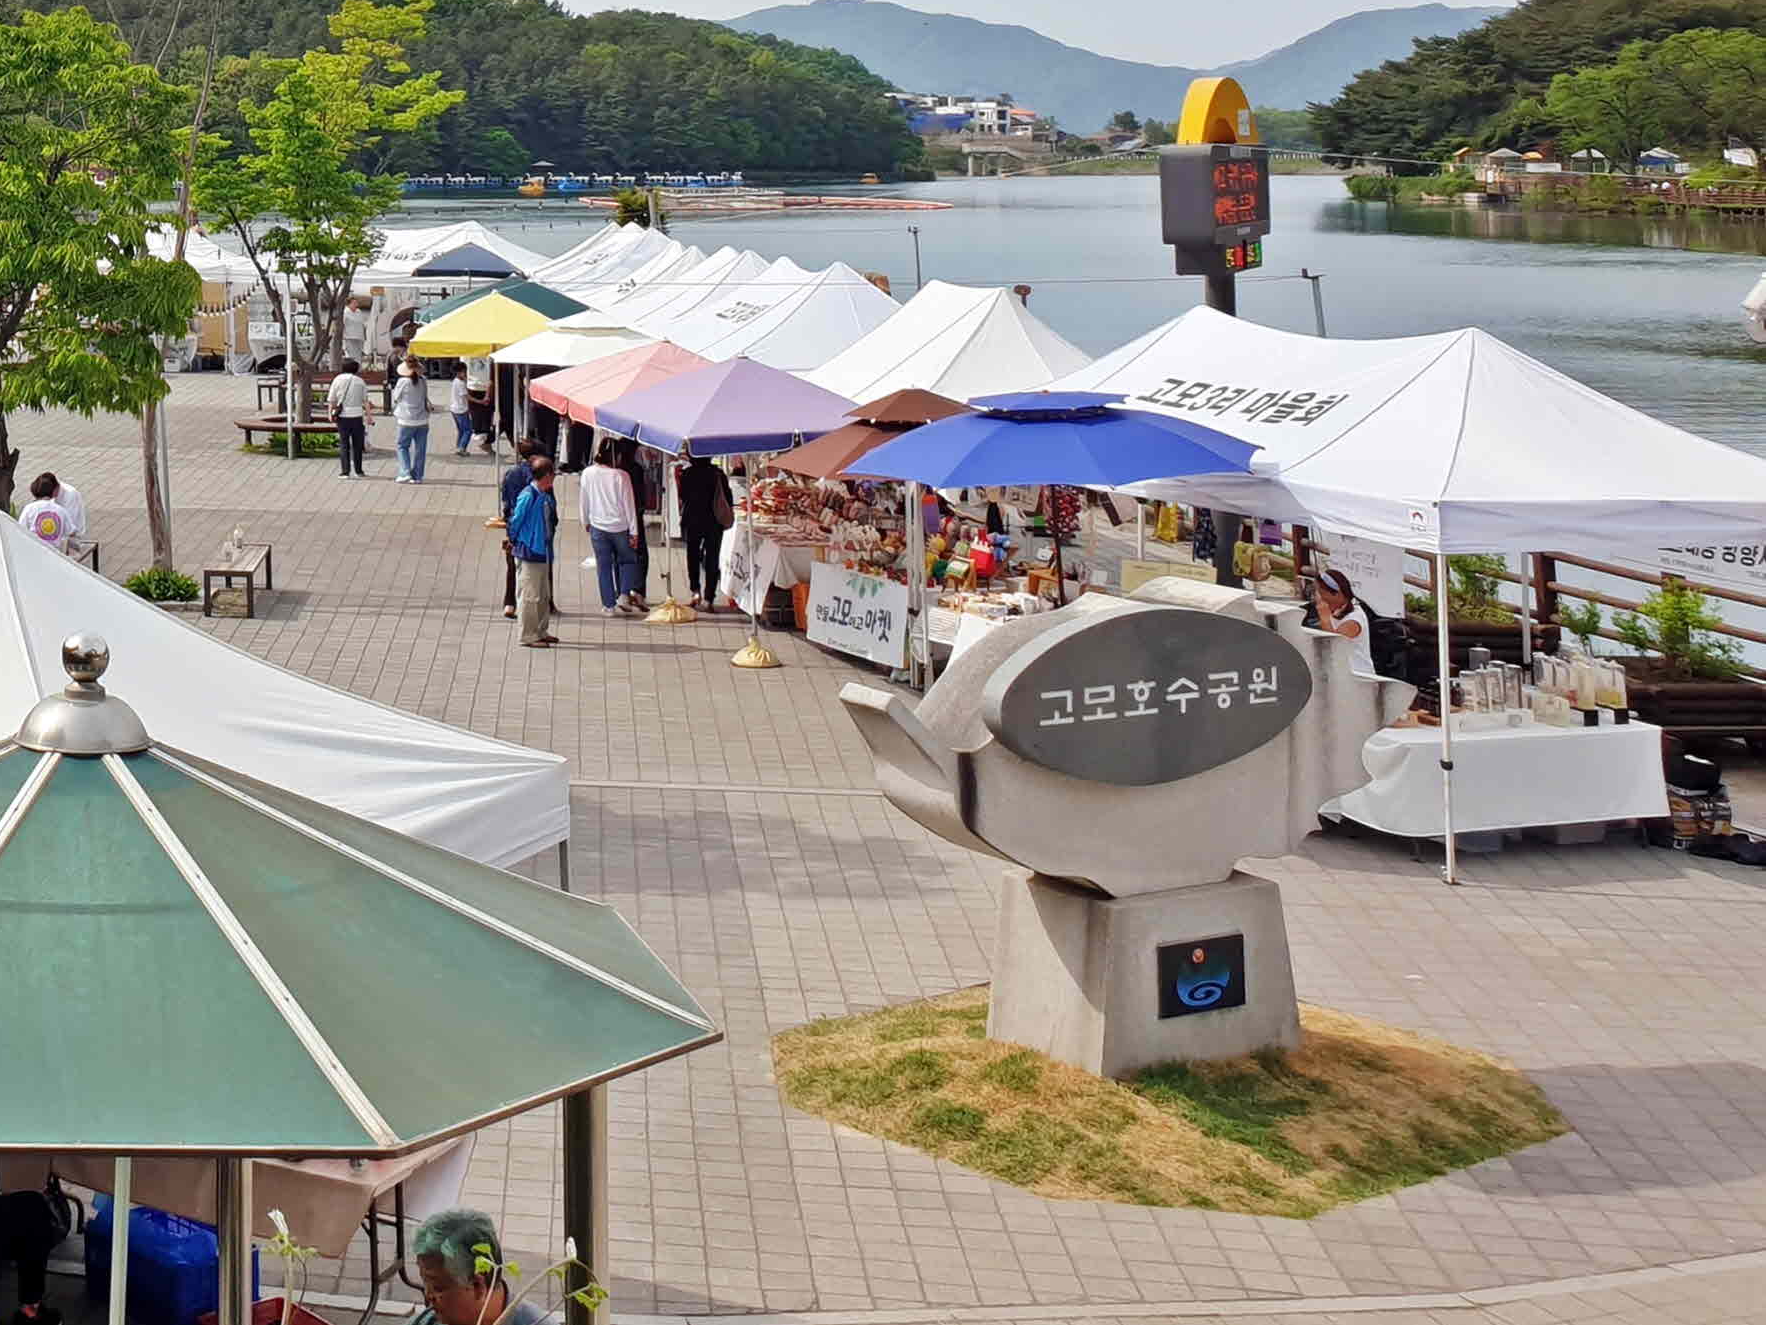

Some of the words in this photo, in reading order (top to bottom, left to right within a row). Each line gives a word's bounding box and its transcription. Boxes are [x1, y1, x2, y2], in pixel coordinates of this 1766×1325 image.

[1136, 377, 1258, 417] 고모3리
[1240, 389, 1349, 427] 마을회
[1039, 666, 1279, 726] 고모호수공원
